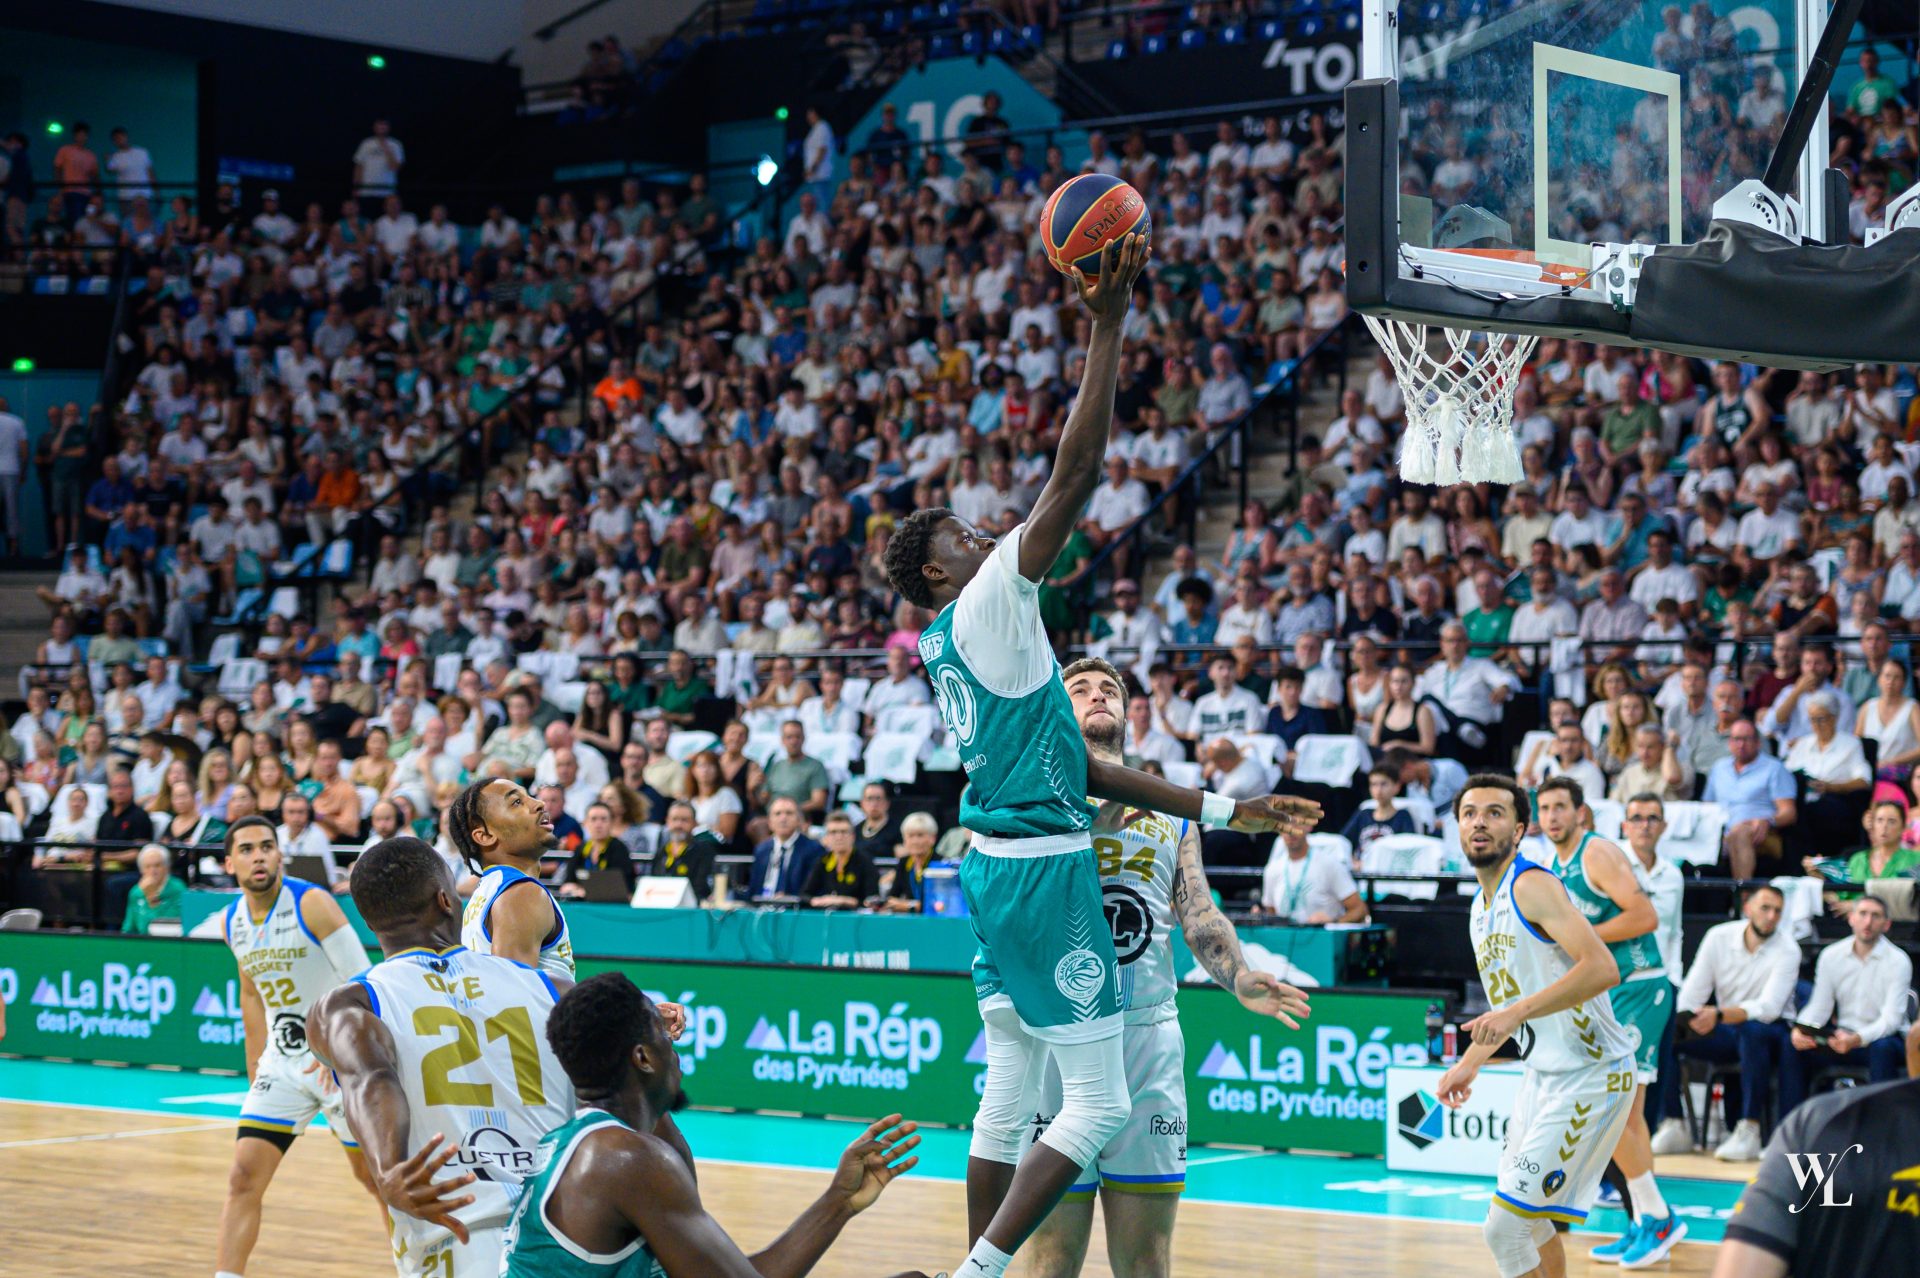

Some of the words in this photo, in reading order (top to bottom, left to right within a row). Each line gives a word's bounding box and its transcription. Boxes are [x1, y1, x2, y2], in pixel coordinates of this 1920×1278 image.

[1083, 191, 1142, 246] SPALDING
[1092, 838, 1156, 882] 84
[61, 970, 97, 1009] La
[103, 962, 176, 1024] Rép
[226, 979, 243, 1018] L
[260, 978, 302, 1008] 22
[36, 1009, 67, 1032] des
[68, 1010, 152, 1039] Pyrénées
[198, 1019, 232, 1044] des
[788, 1009, 835, 1055] La
[844, 1000, 942, 1073] Rép
[412, 1006, 546, 1107] 21
[753, 1055, 795, 1082] des
[797, 1056, 909, 1090] Pyrénées
[1249, 1034, 1304, 1084] La
[1607, 1072, 1633, 1092] 20
[1208, 1083, 1256, 1114] des
[1260, 1085, 1387, 1121] Pyrénées
[421, 1249, 454, 1278] 21
